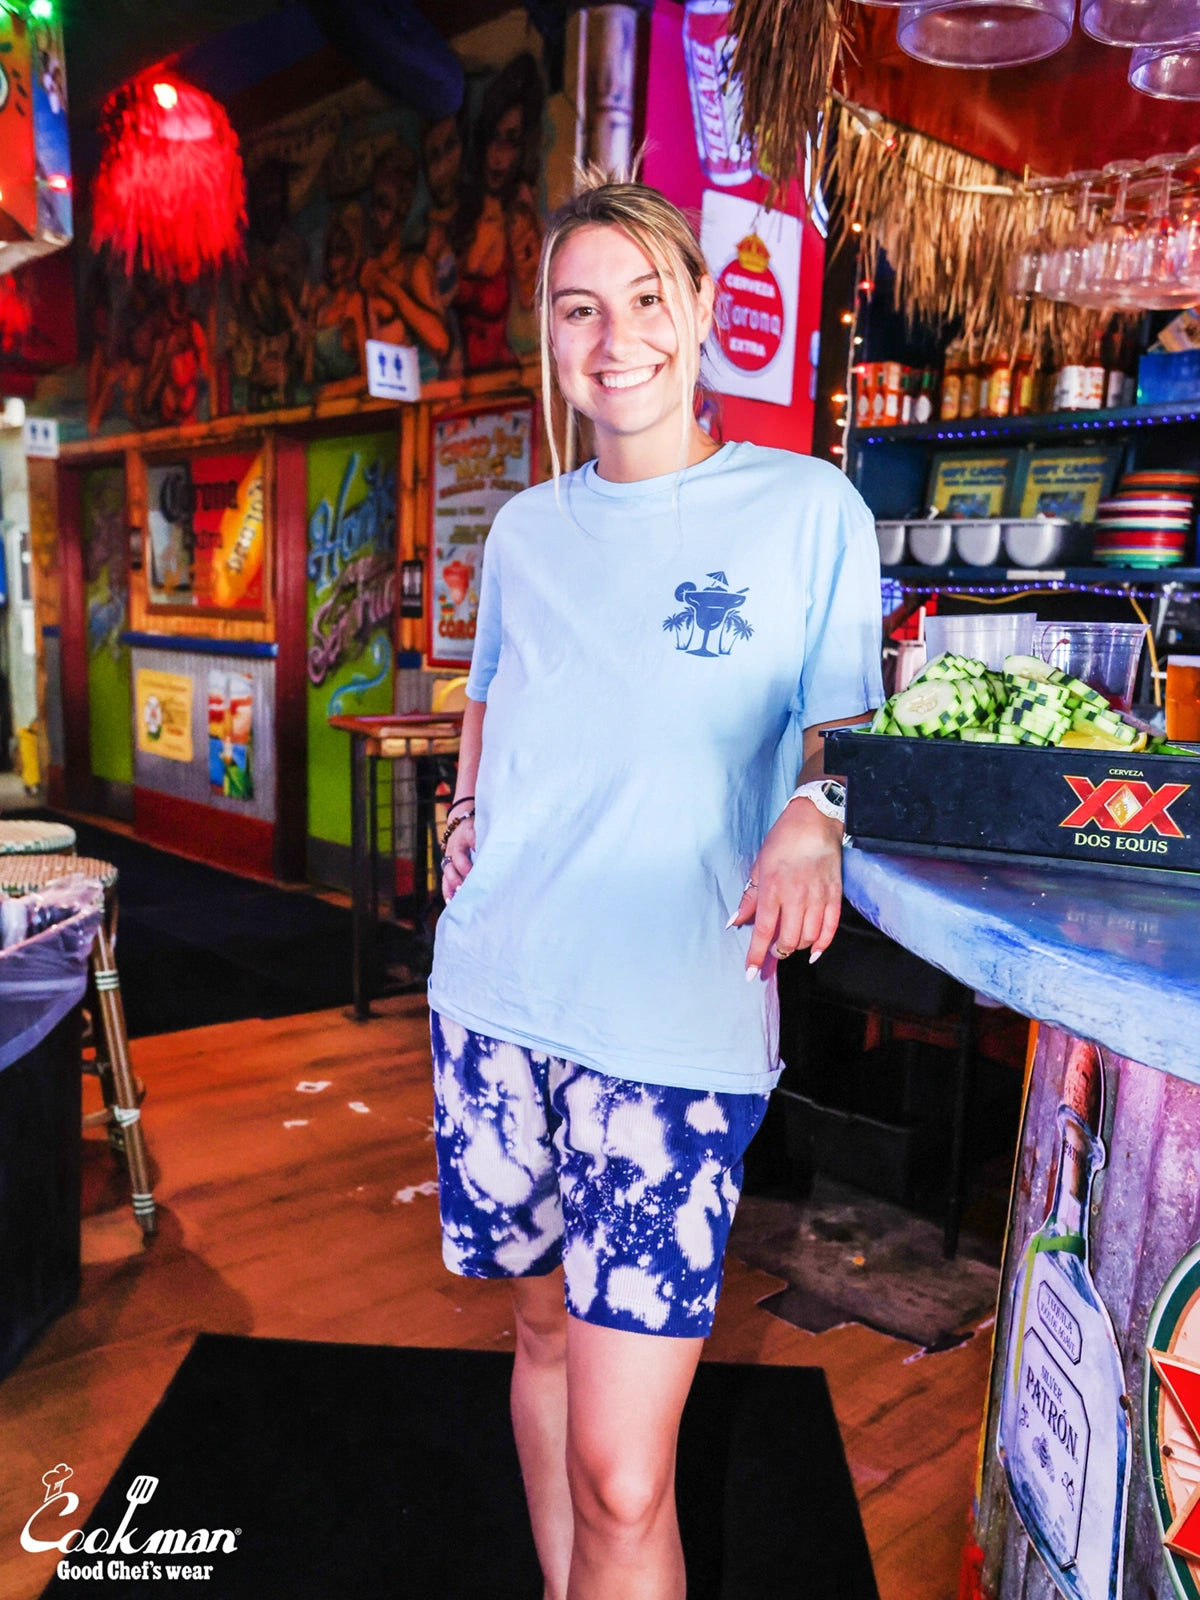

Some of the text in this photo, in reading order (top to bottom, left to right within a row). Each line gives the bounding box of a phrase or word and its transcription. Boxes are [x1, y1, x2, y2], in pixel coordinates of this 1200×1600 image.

[715, 292, 781, 339] Corona
[729, 336, 767, 357] EXTRA
[1108, 768, 1144, 778] CERVEZA
[1058, 774, 1192, 839] XX
[1074, 832, 1169, 855] DOS EQUIS
[1041, 1364, 1063, 1406] SILVER
[1026, 1364, 1079, 1461] PATRÓN
